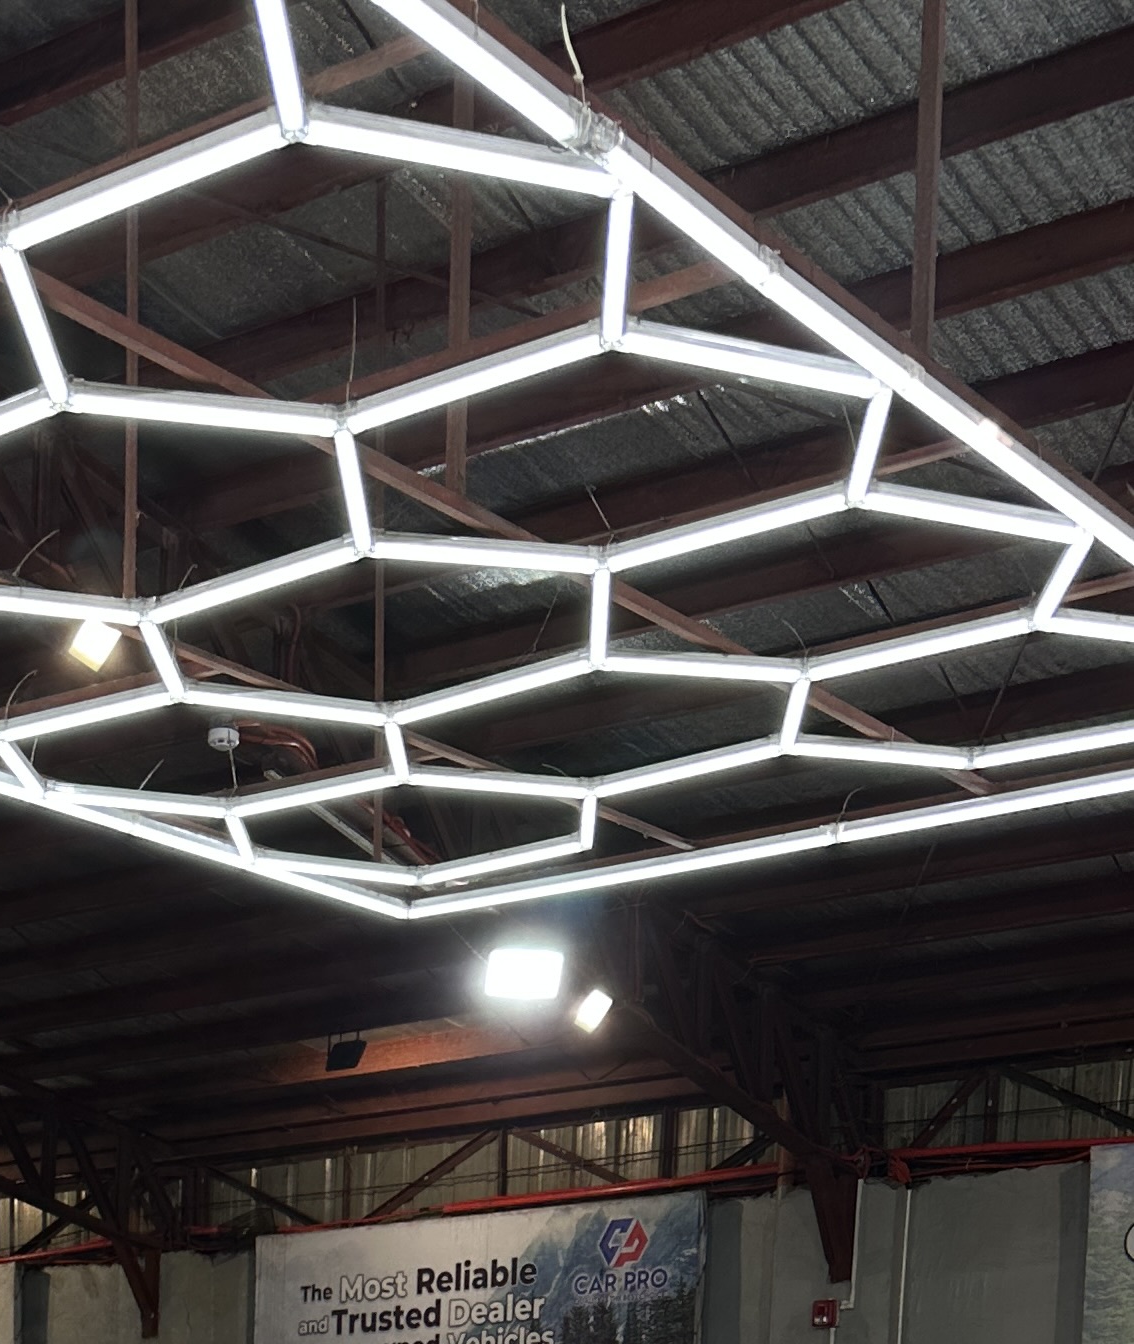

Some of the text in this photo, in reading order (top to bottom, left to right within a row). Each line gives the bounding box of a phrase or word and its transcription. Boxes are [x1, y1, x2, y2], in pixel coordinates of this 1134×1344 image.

[301, 1257, 538, 1304] The Most Reliable
[573, 1267, 669, 1296] CAR PRO
[298, 1316, 329, 1336] and
[331, 1299, 441, 1336] Trusted
[448, 1294, 545, 1328] Dealer
